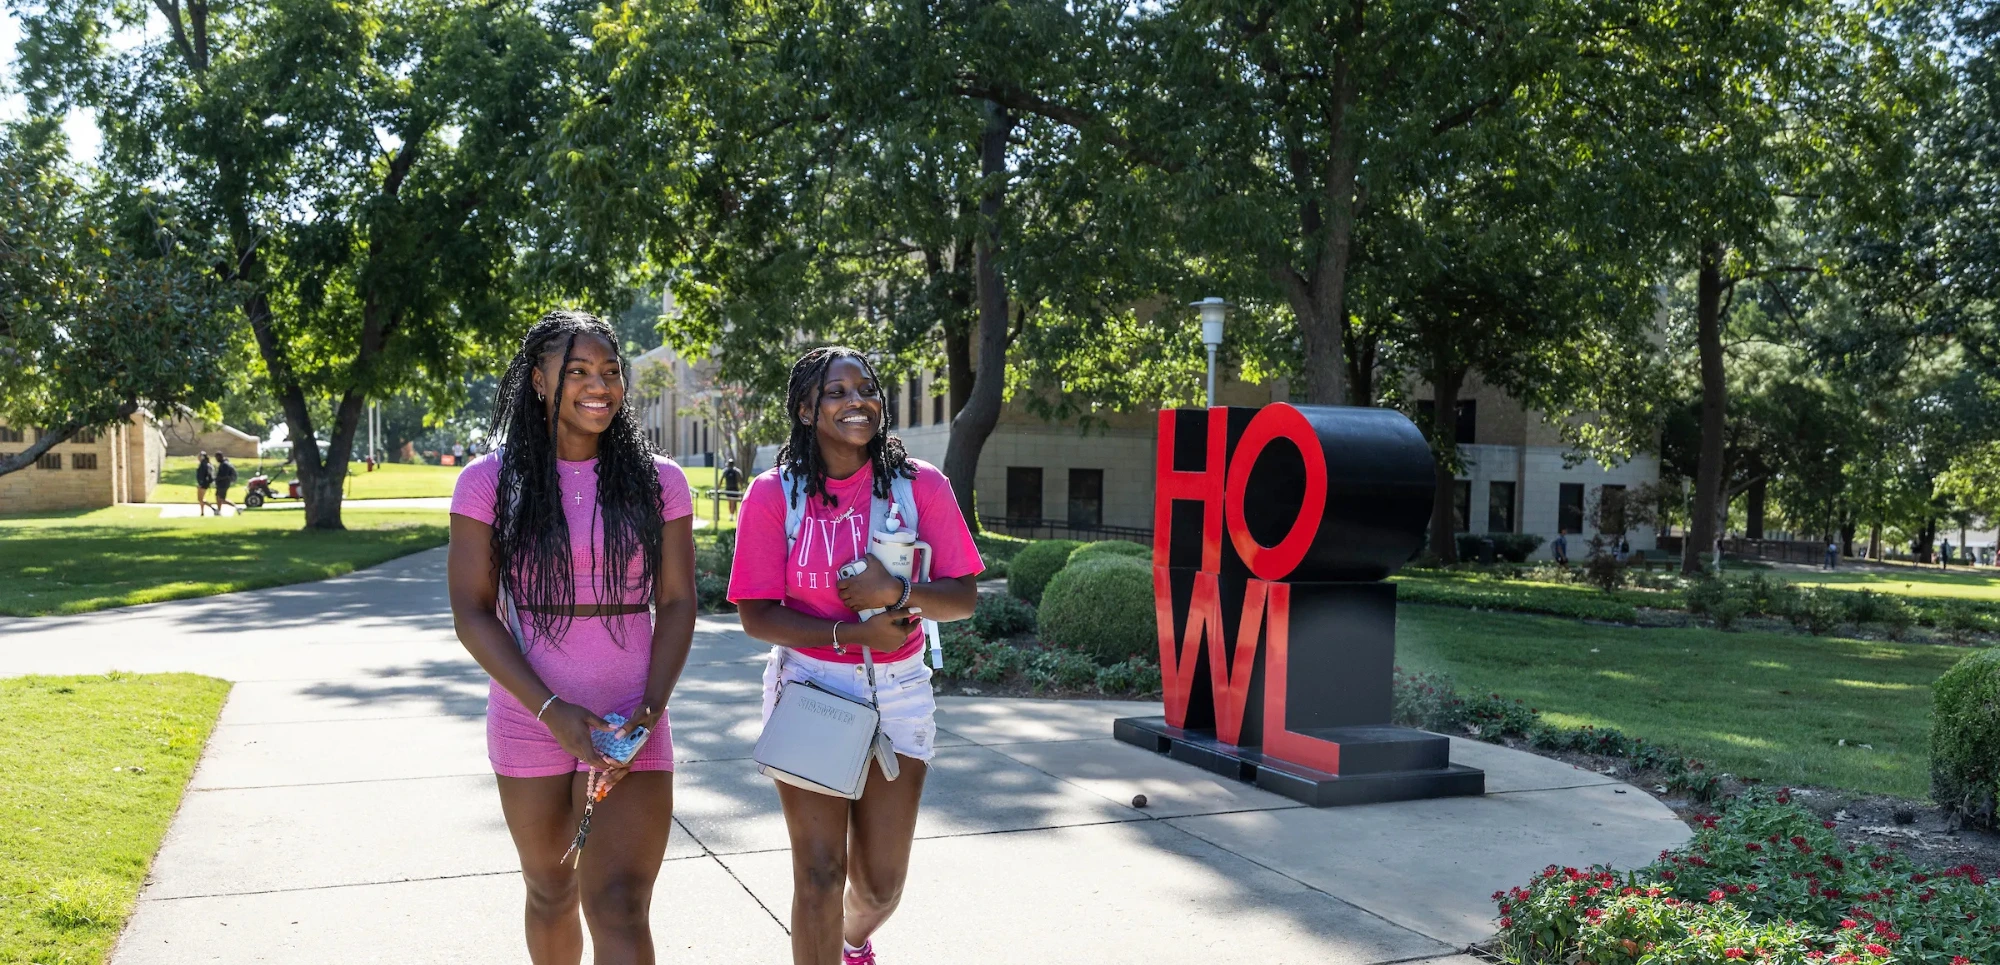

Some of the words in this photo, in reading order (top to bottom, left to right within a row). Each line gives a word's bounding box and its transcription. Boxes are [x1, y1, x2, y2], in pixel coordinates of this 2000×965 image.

[797, 570, 841, 589] THI
[1153, 402, 1328, 582] HO
[1153, 566, 1340, 777] WL
